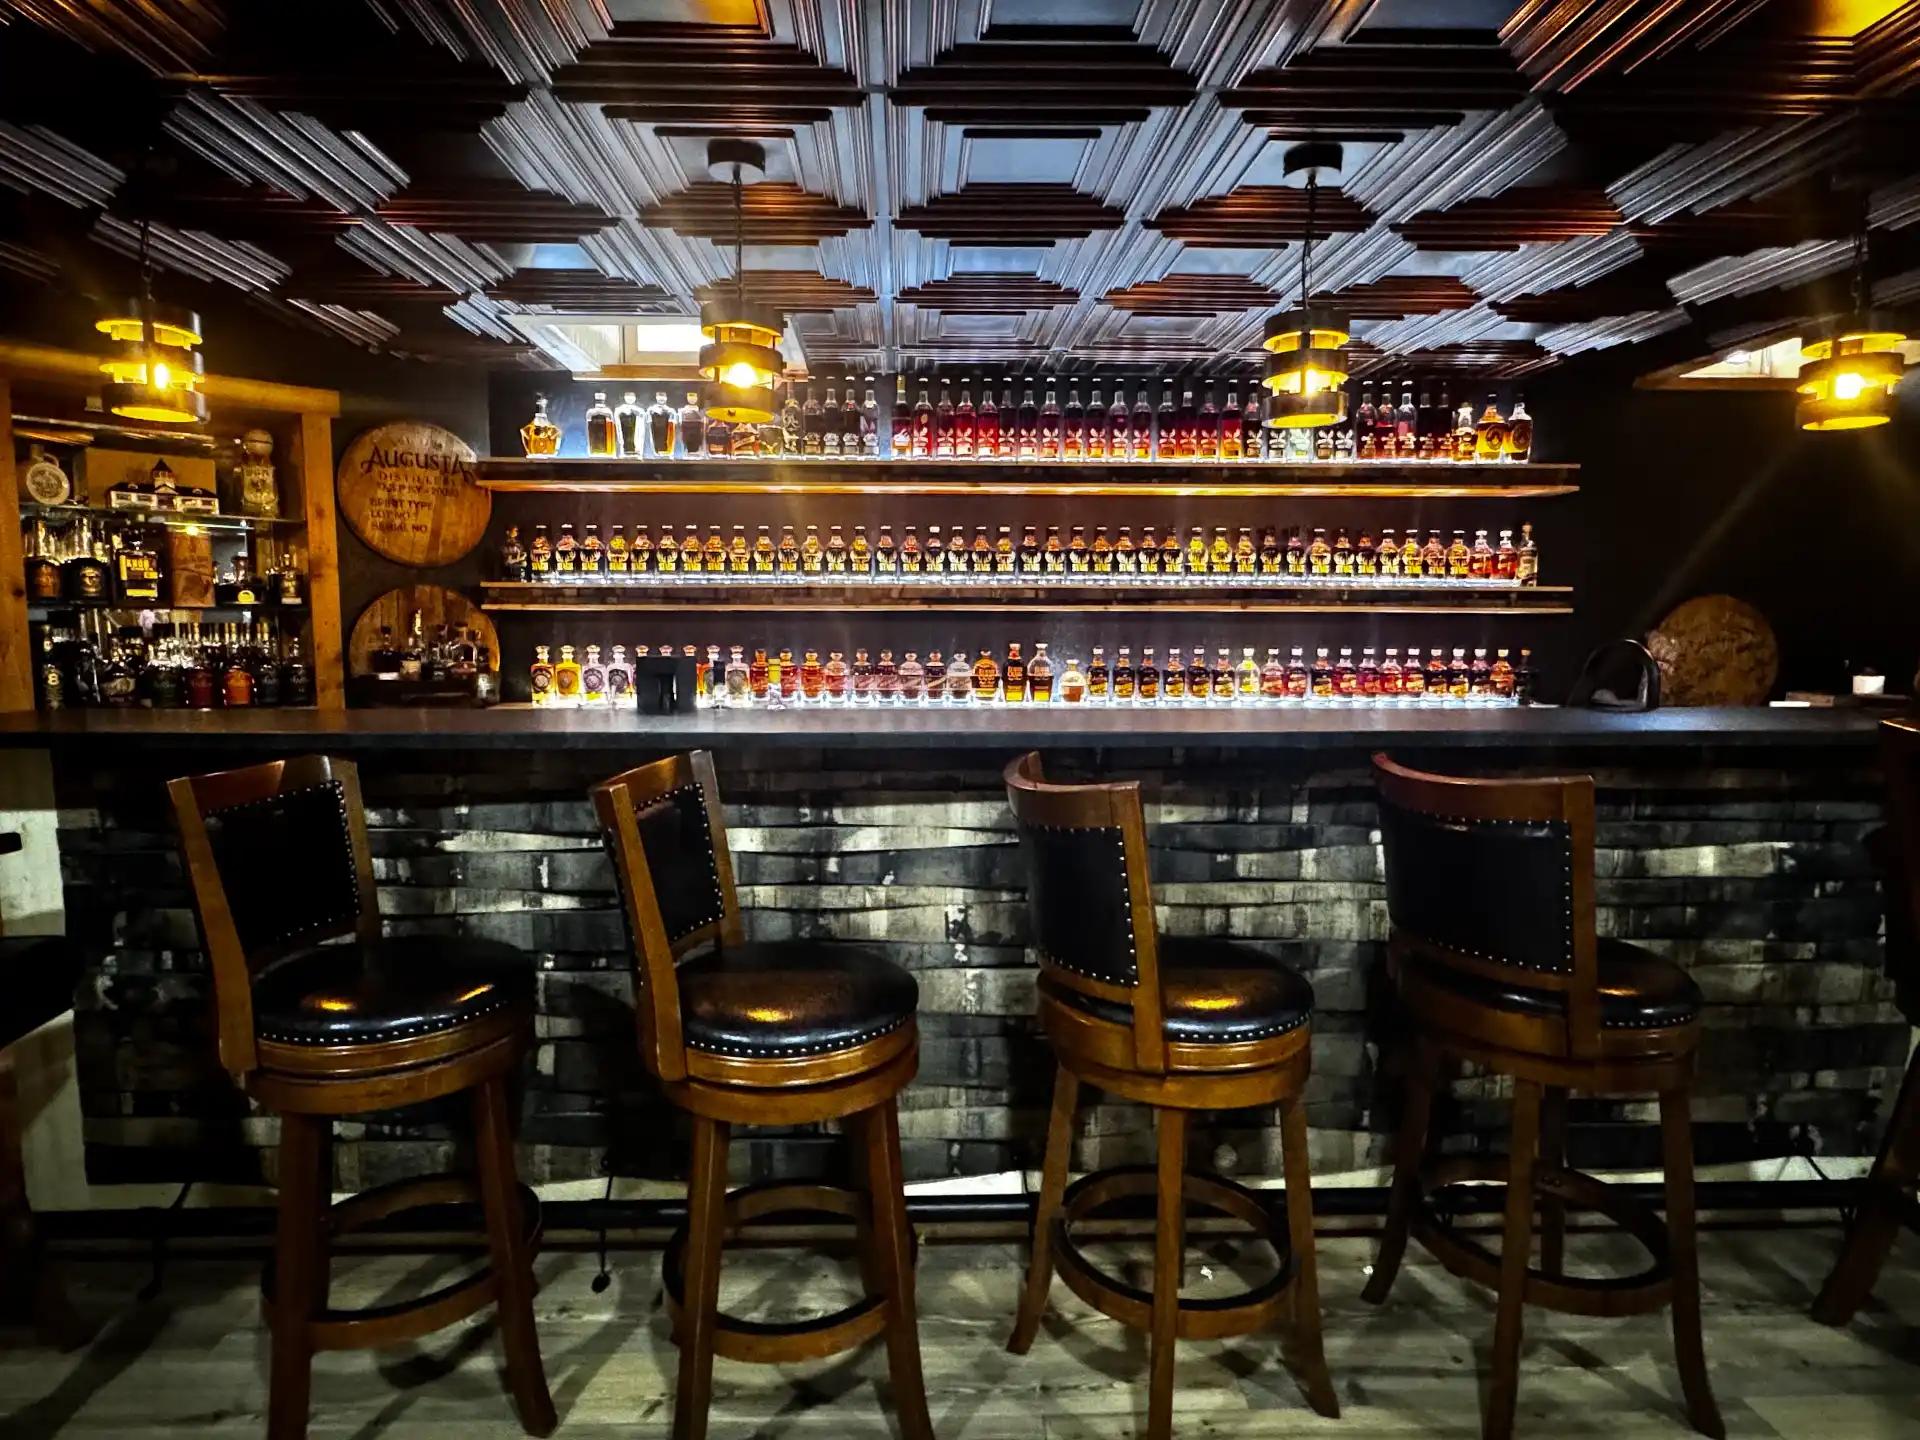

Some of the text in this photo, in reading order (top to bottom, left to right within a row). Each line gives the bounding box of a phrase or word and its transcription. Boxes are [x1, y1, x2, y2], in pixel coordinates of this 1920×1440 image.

[361, 446, 474, 483] AUGUSTA
[408, 499, 433, 511] TYPE
[412, 523, 428, 533] NO
